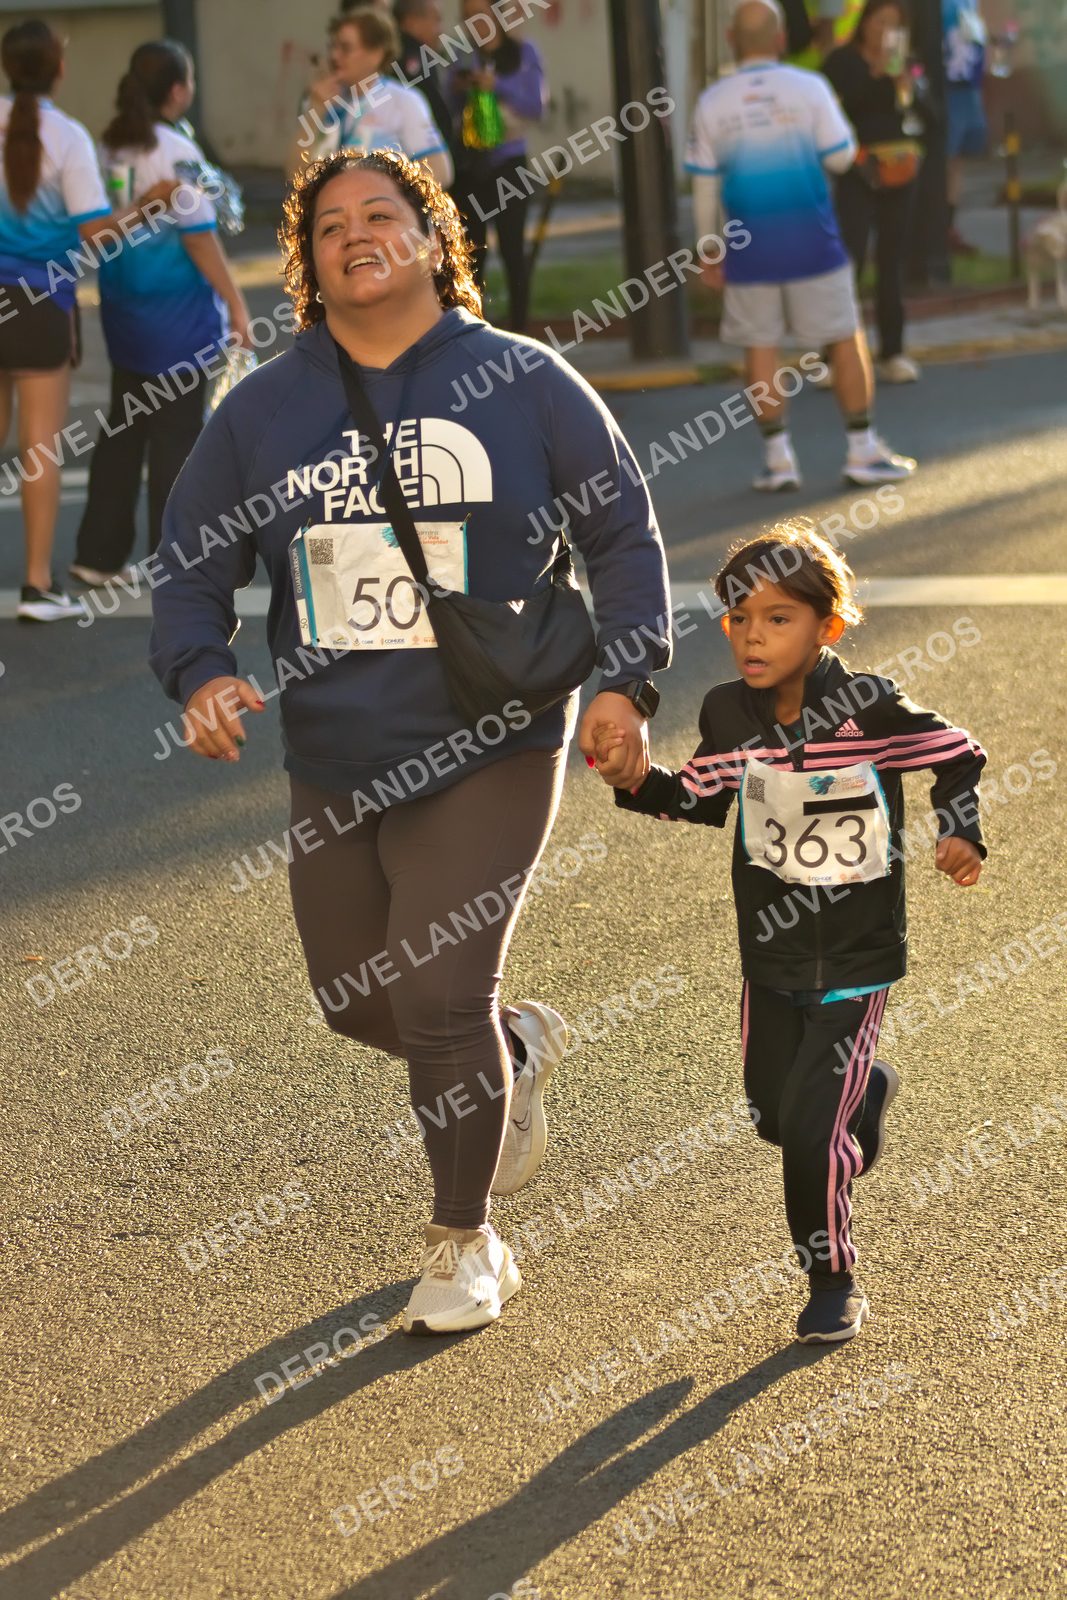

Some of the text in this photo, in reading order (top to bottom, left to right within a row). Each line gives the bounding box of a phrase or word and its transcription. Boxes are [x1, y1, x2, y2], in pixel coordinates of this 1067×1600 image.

[342, 418, 419, 456] TE
[287, 447, 419, 499] NORH
[324, 477, 420, 522] FACE
[300, 617, 308, 629] 50
[347, 575, 421, 631] 50
[835, 729, 864, 738] adidas
[764, 815, 867, 868] 363
